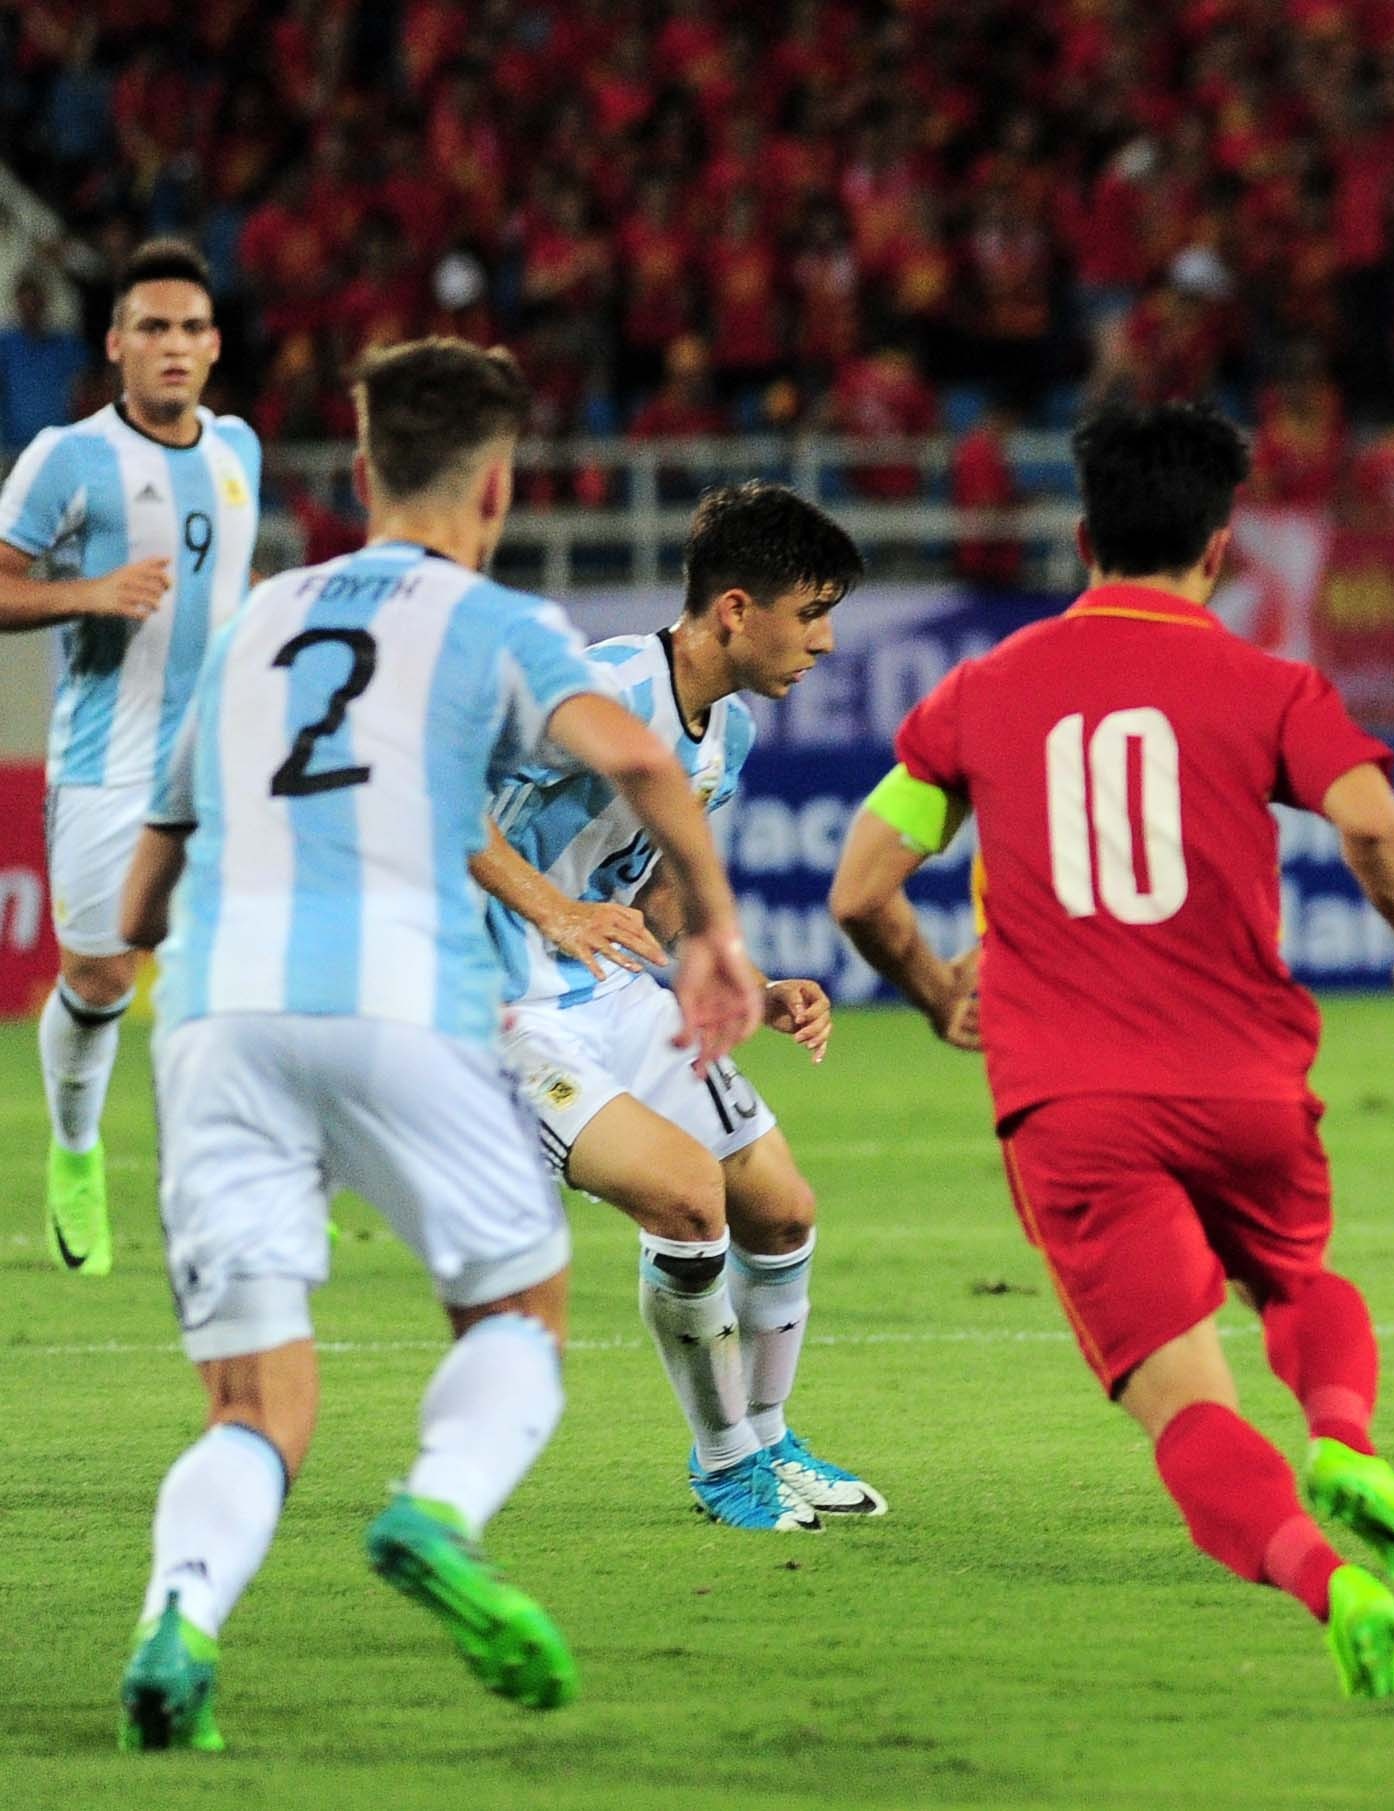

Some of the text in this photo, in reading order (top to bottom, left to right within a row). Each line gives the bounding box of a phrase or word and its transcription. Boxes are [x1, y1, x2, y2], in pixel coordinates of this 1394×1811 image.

[185, 511, 213, 573] 9
[269, 627, 379, 797] 2
[1046, 706, 1189, 925] 10
